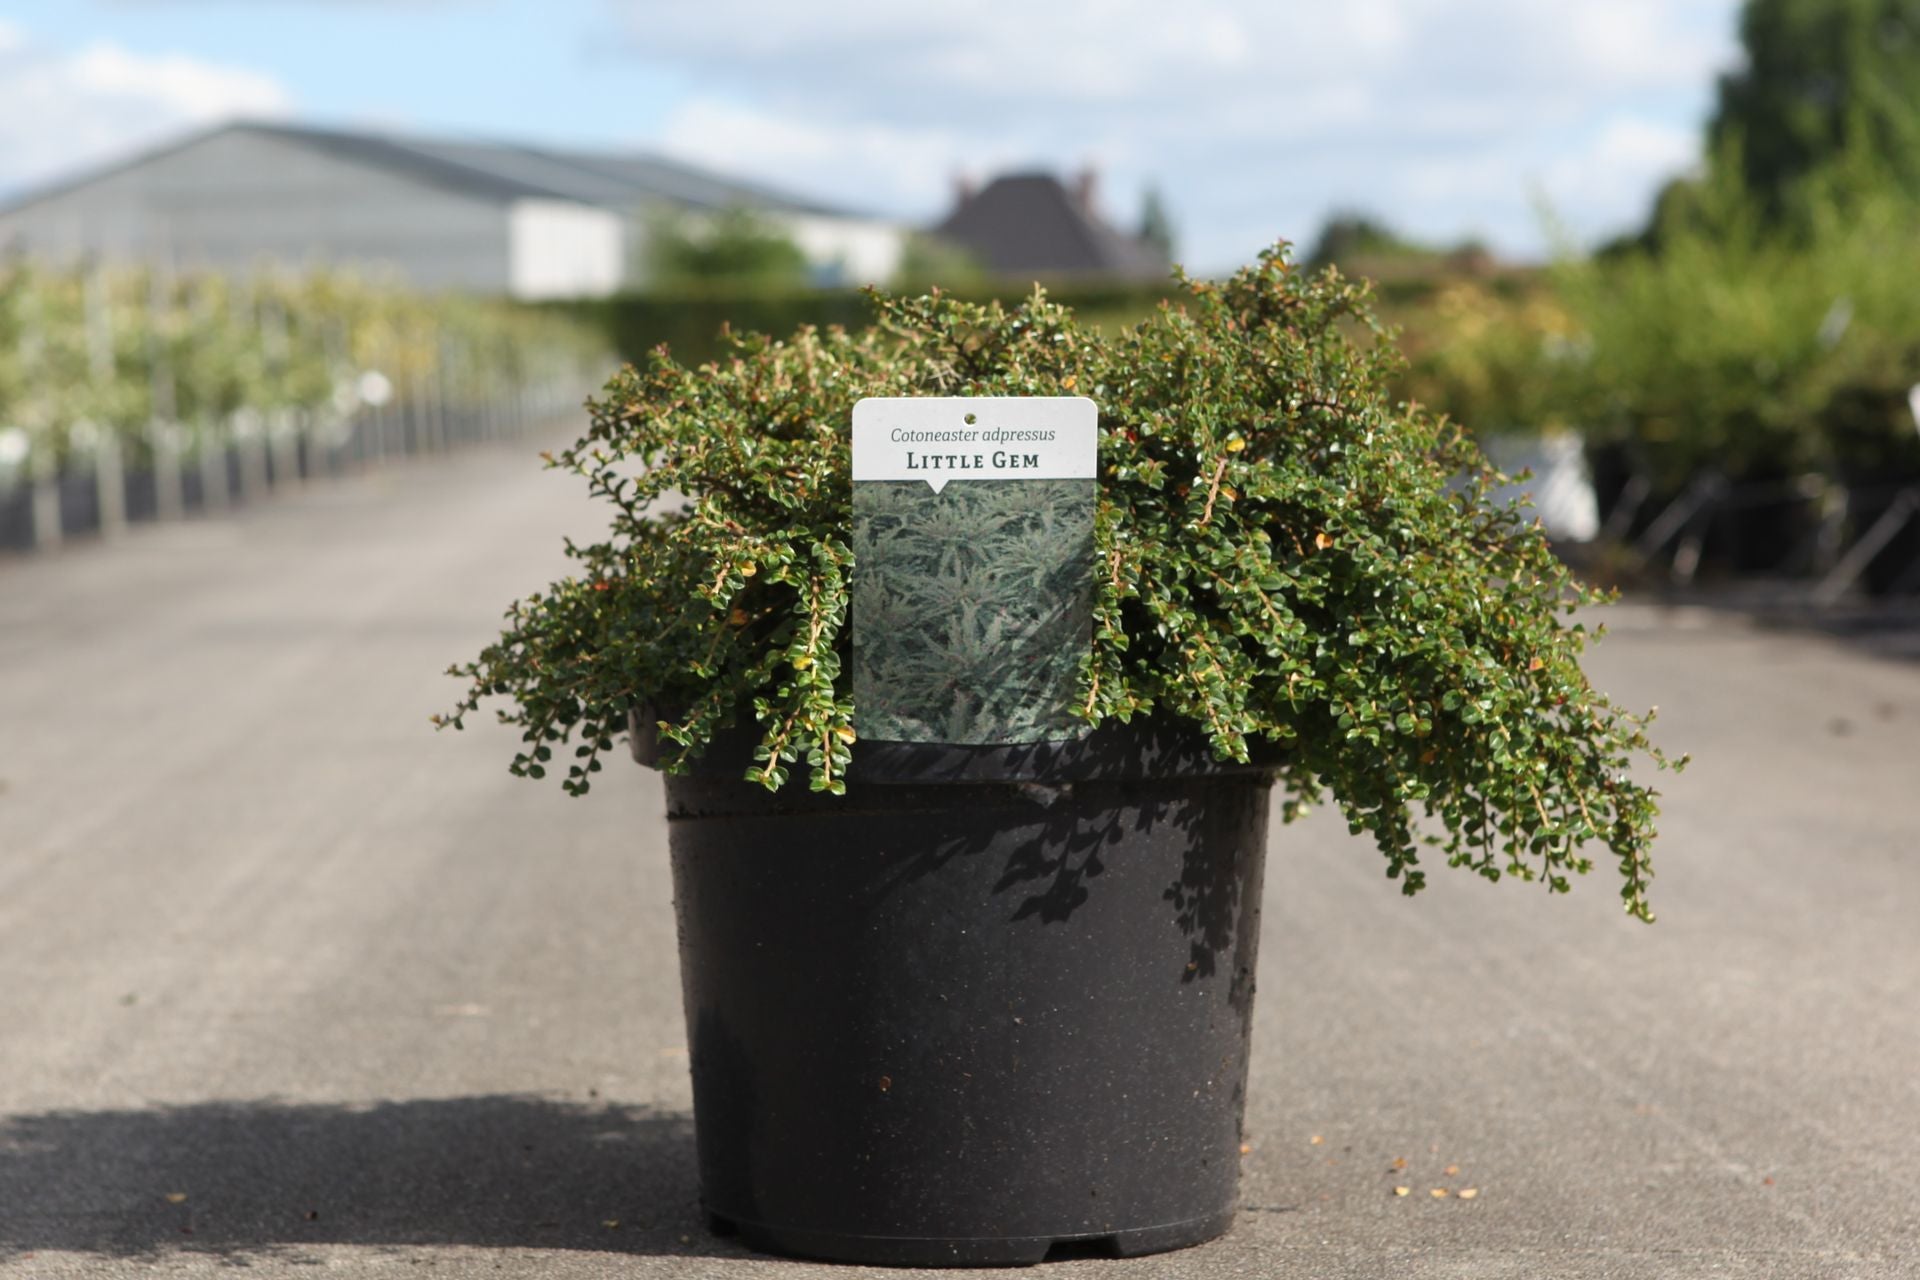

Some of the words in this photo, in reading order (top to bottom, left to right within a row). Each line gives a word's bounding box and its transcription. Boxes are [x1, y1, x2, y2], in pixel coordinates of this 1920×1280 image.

[891, 427, 979, 443] Cotoneaster
[982, 427, 1056, 445] adpressus
[906, 451, 984, 469] LITTLE
[992, 450, 1039, 469] GEM
